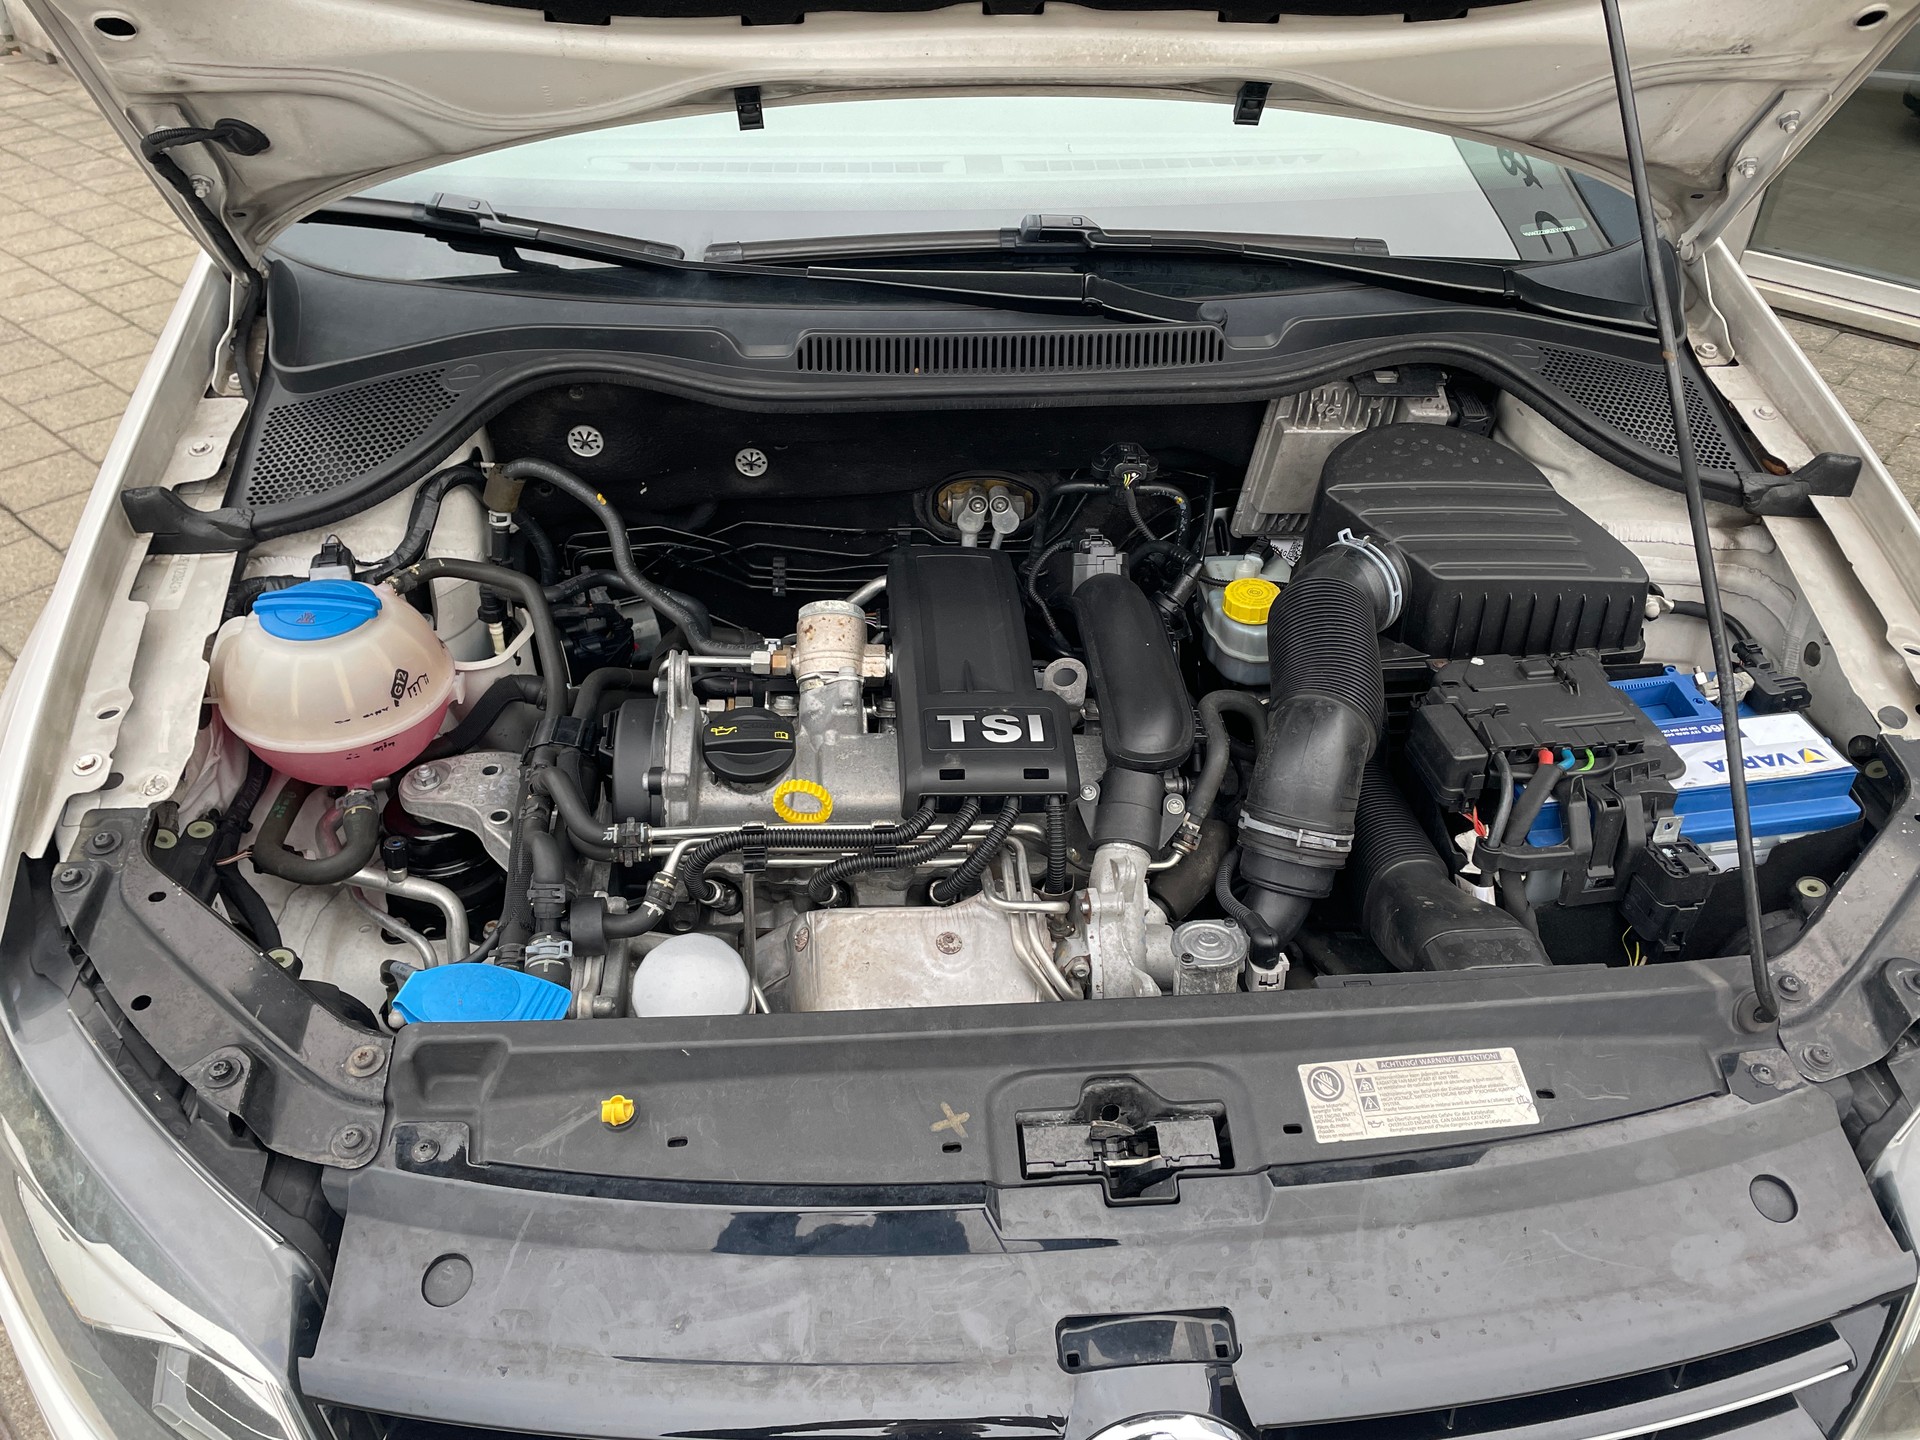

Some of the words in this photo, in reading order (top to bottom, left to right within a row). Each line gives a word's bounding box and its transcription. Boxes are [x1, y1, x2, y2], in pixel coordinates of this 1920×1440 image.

[392, 670, 408, 697] G12
[936, 714, 1046, 743] TSI
[1703, 752, 1800, 773] VARA
[1380, 1059, 1418, 1068] ACHTUNG!
[1418, 1056, 1457, 1064] WARNING!
[1457, 1053, 1498, 1061] ATTENTION!
